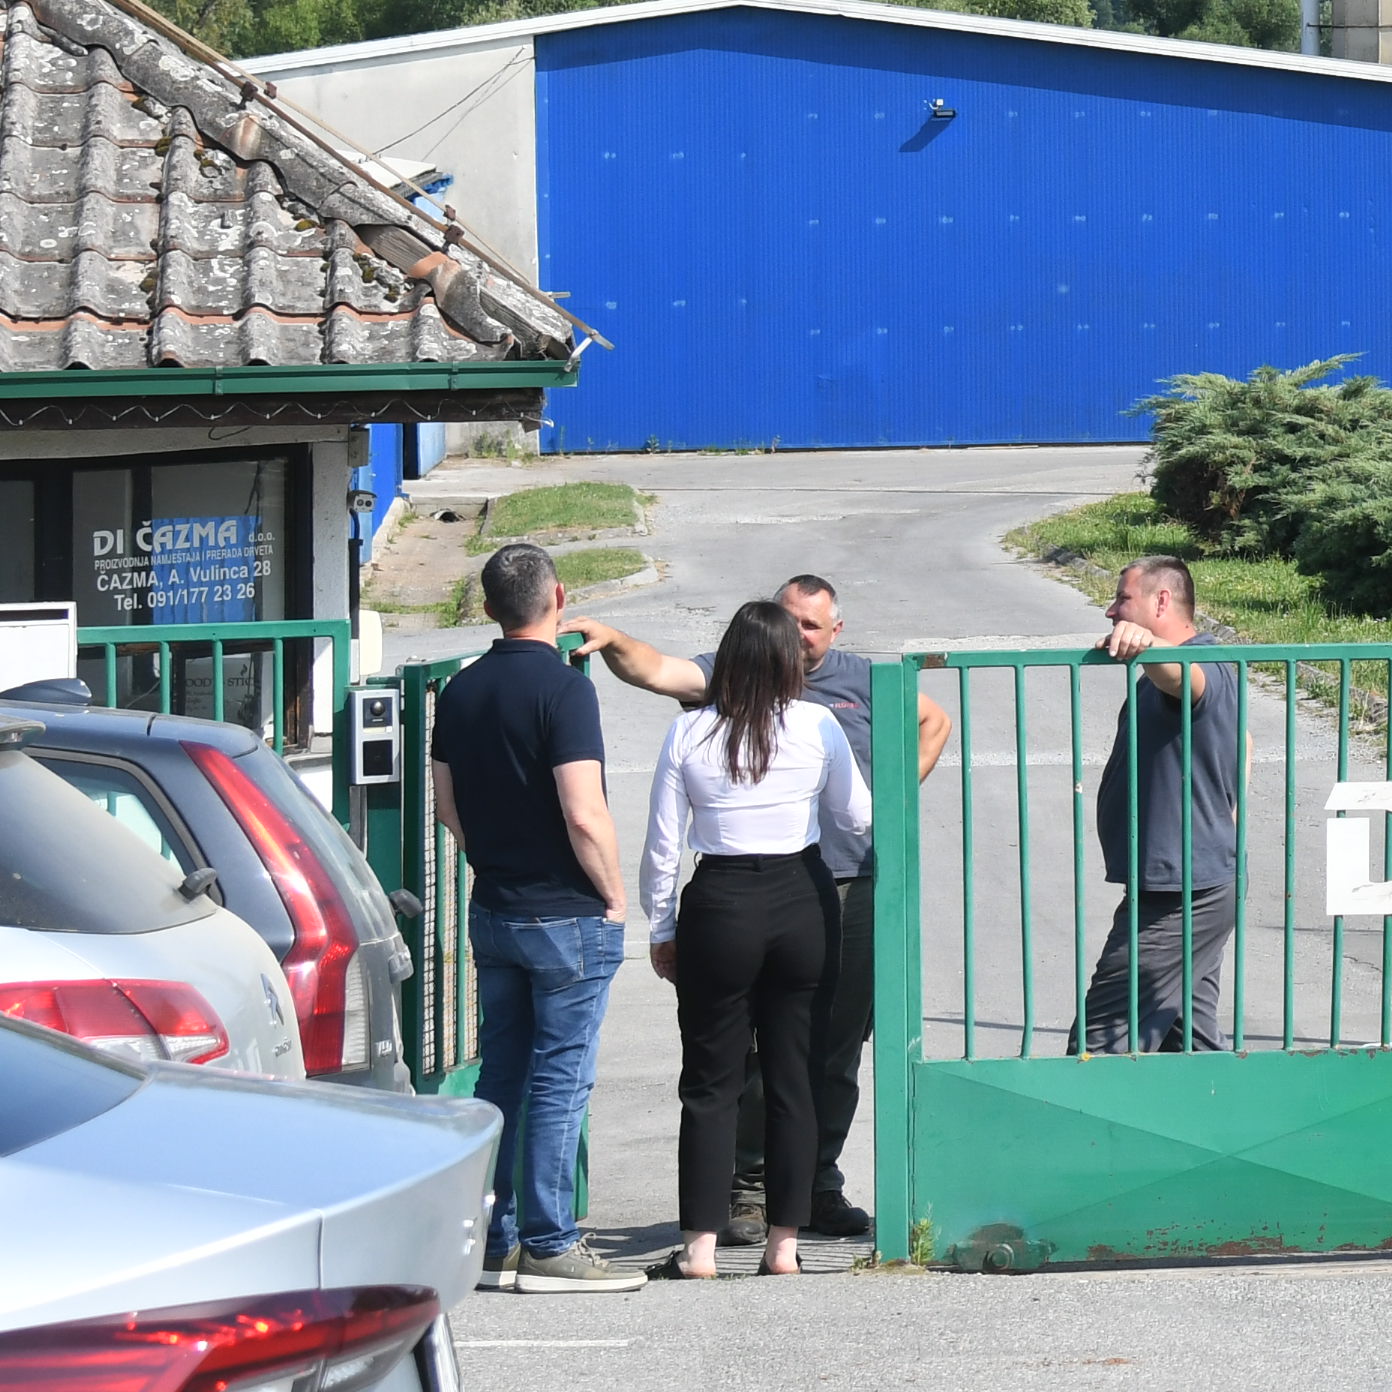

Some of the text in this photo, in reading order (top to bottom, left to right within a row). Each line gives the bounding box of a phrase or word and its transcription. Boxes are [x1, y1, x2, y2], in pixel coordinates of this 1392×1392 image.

[93, 519, 276, 556] DI ČAZMA d.o.o.
[95, 556, 149, 570] PROIZVODNJA
[151, 550, 200, 566] NAMJEŠTAJA
[206, 546, 242, 560] PRERADA
[243, 544, 273, 557] DRVETA
[97, 560, 272, 591] ČAZMA, A. Vulinca 28
[114, 583, 255, 611] Tel. 091/177 23 26
